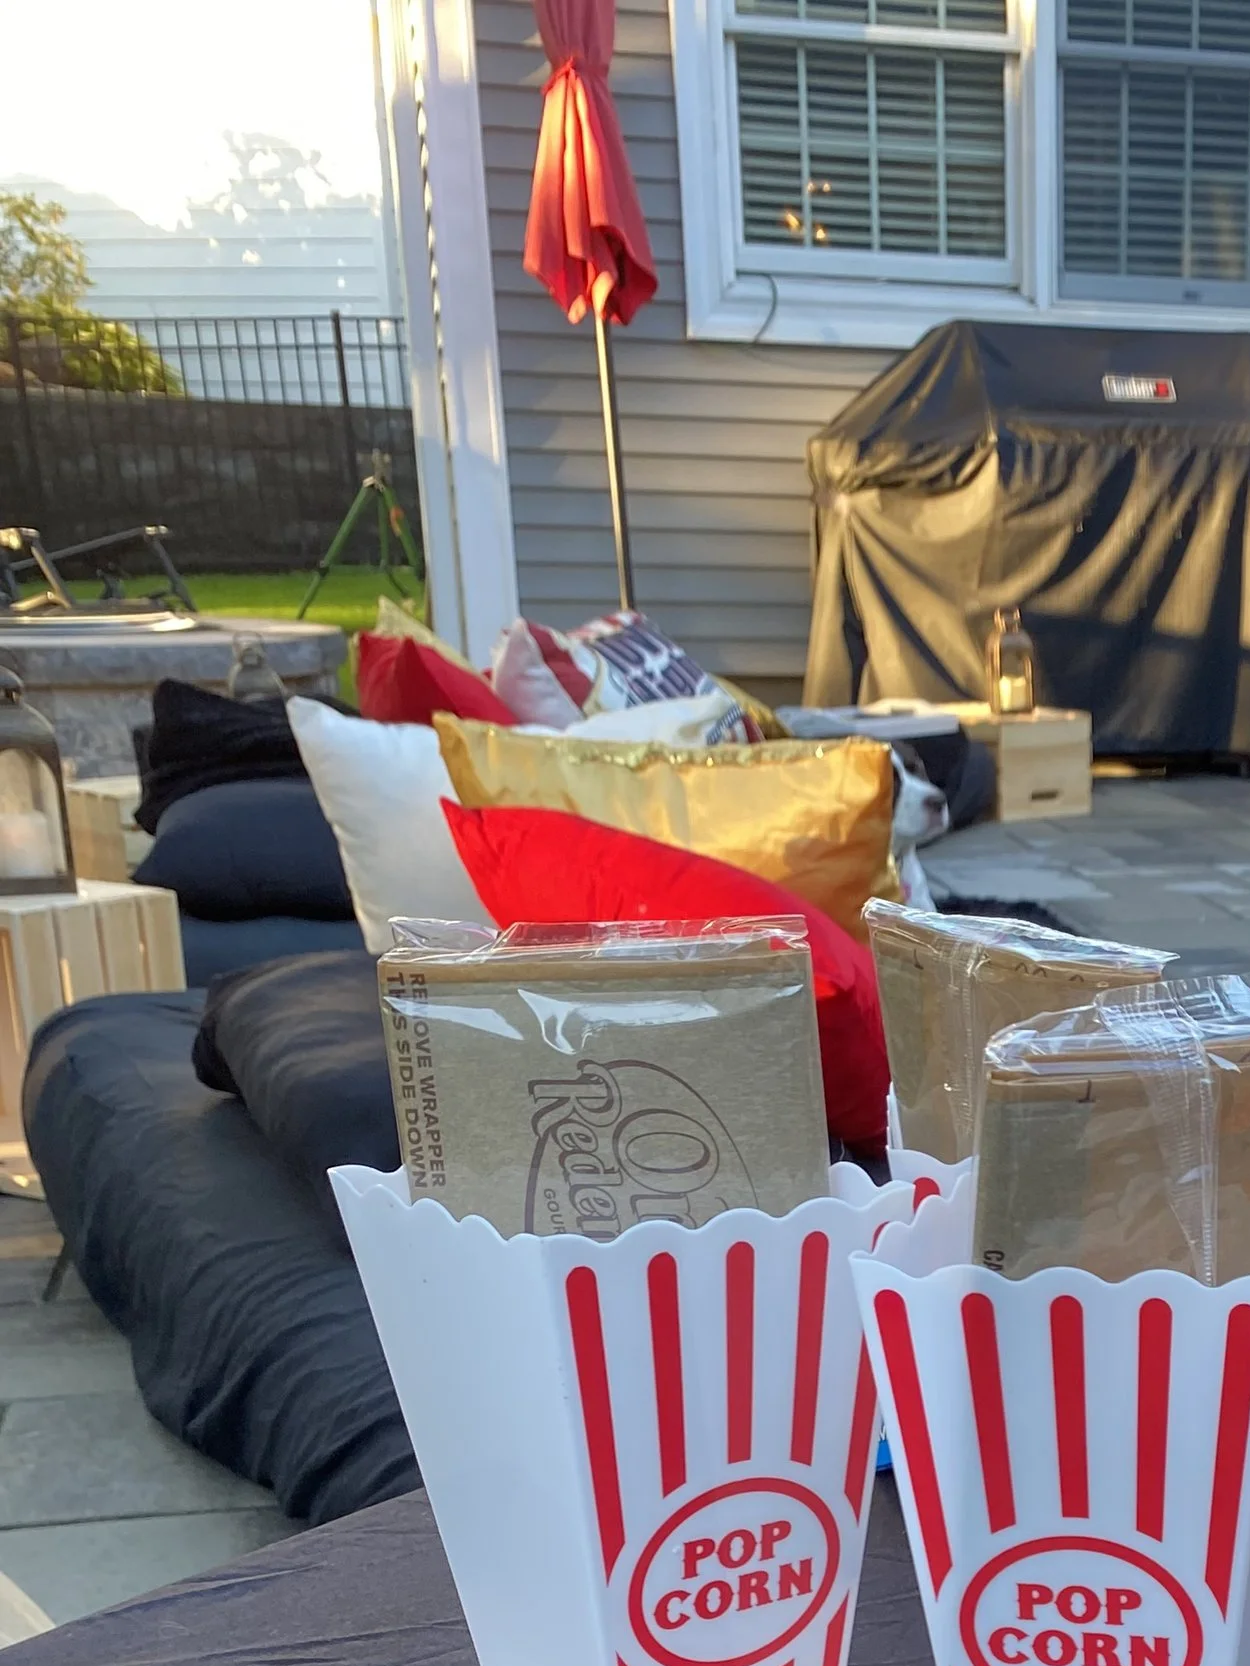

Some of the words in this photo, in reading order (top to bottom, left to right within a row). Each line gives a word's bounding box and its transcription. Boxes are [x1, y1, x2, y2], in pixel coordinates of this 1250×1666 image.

[386, 972, 407, 1031] THS
[396, 1039, 416, 1099] SIDE
[405, 1108, 427, 1188] DOWN
[420, 1074, 446, 1188] WRAPPER
[681, 1520, 792, 1580] POP
[653, 1557, 813, 1630] CORN
[1016, 1582, 1142, 1625] POP
